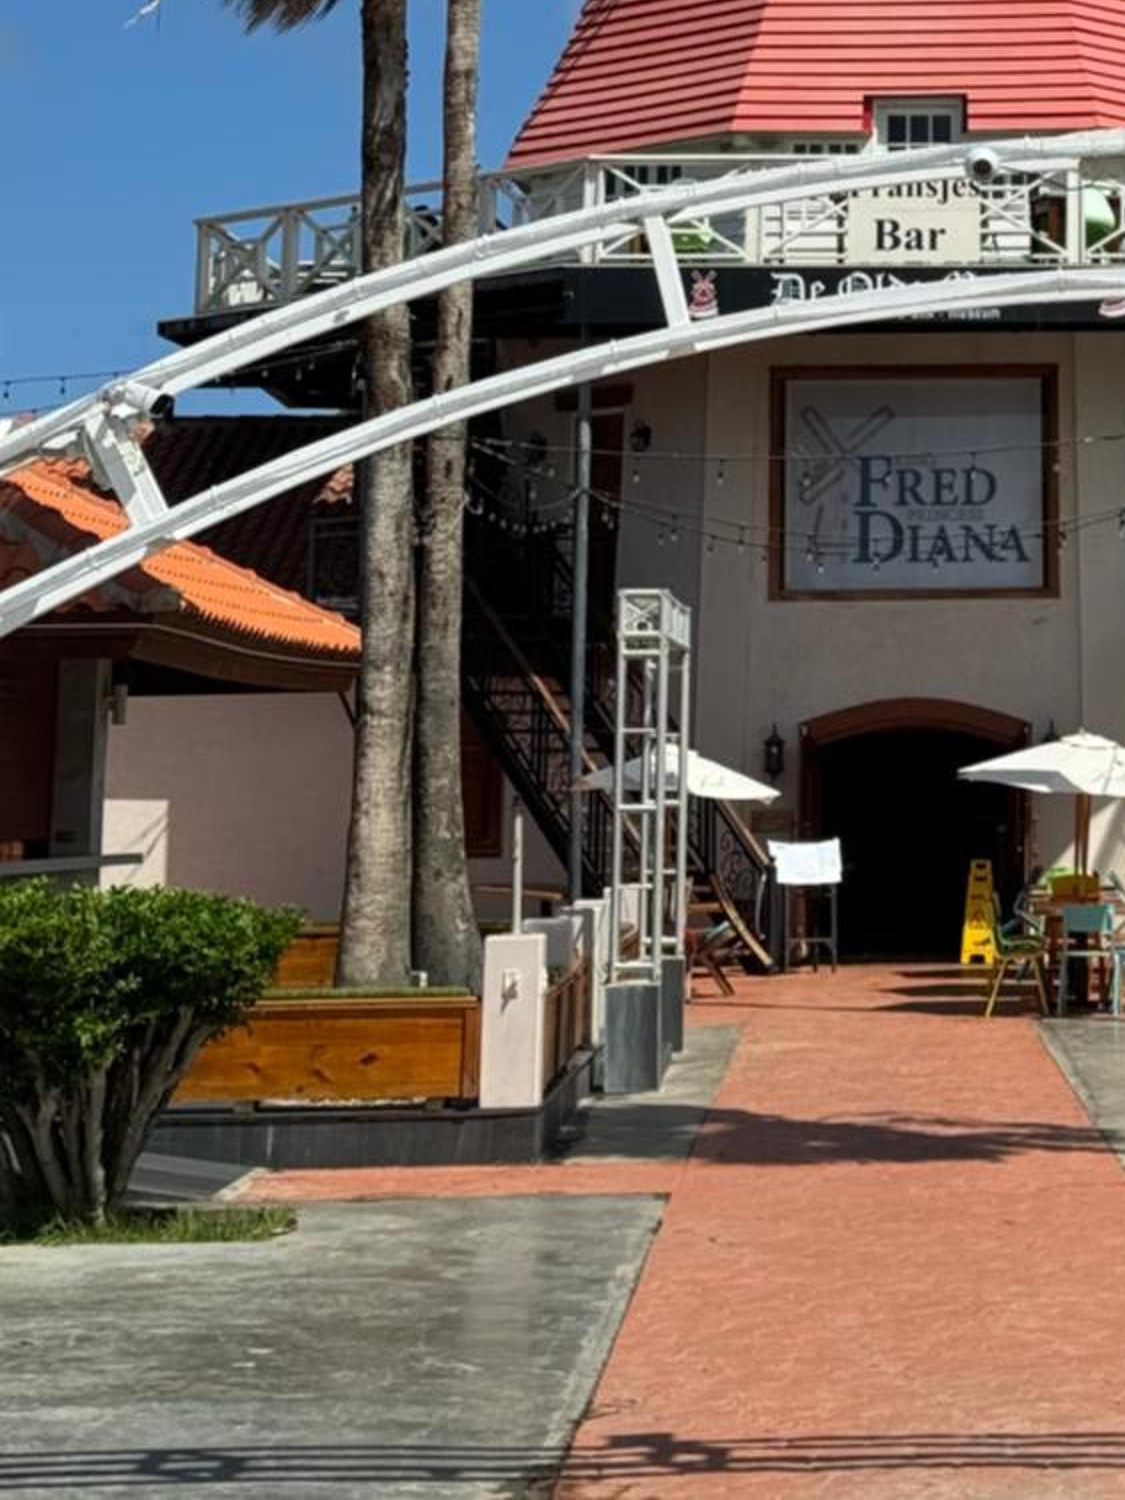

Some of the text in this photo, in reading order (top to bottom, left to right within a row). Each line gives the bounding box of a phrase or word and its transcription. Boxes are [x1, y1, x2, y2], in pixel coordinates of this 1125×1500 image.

[875, 219, 947, 251] Bar
[853, 455, 997, 508] FRED
[852, 510, 1031, 564] DIANA
